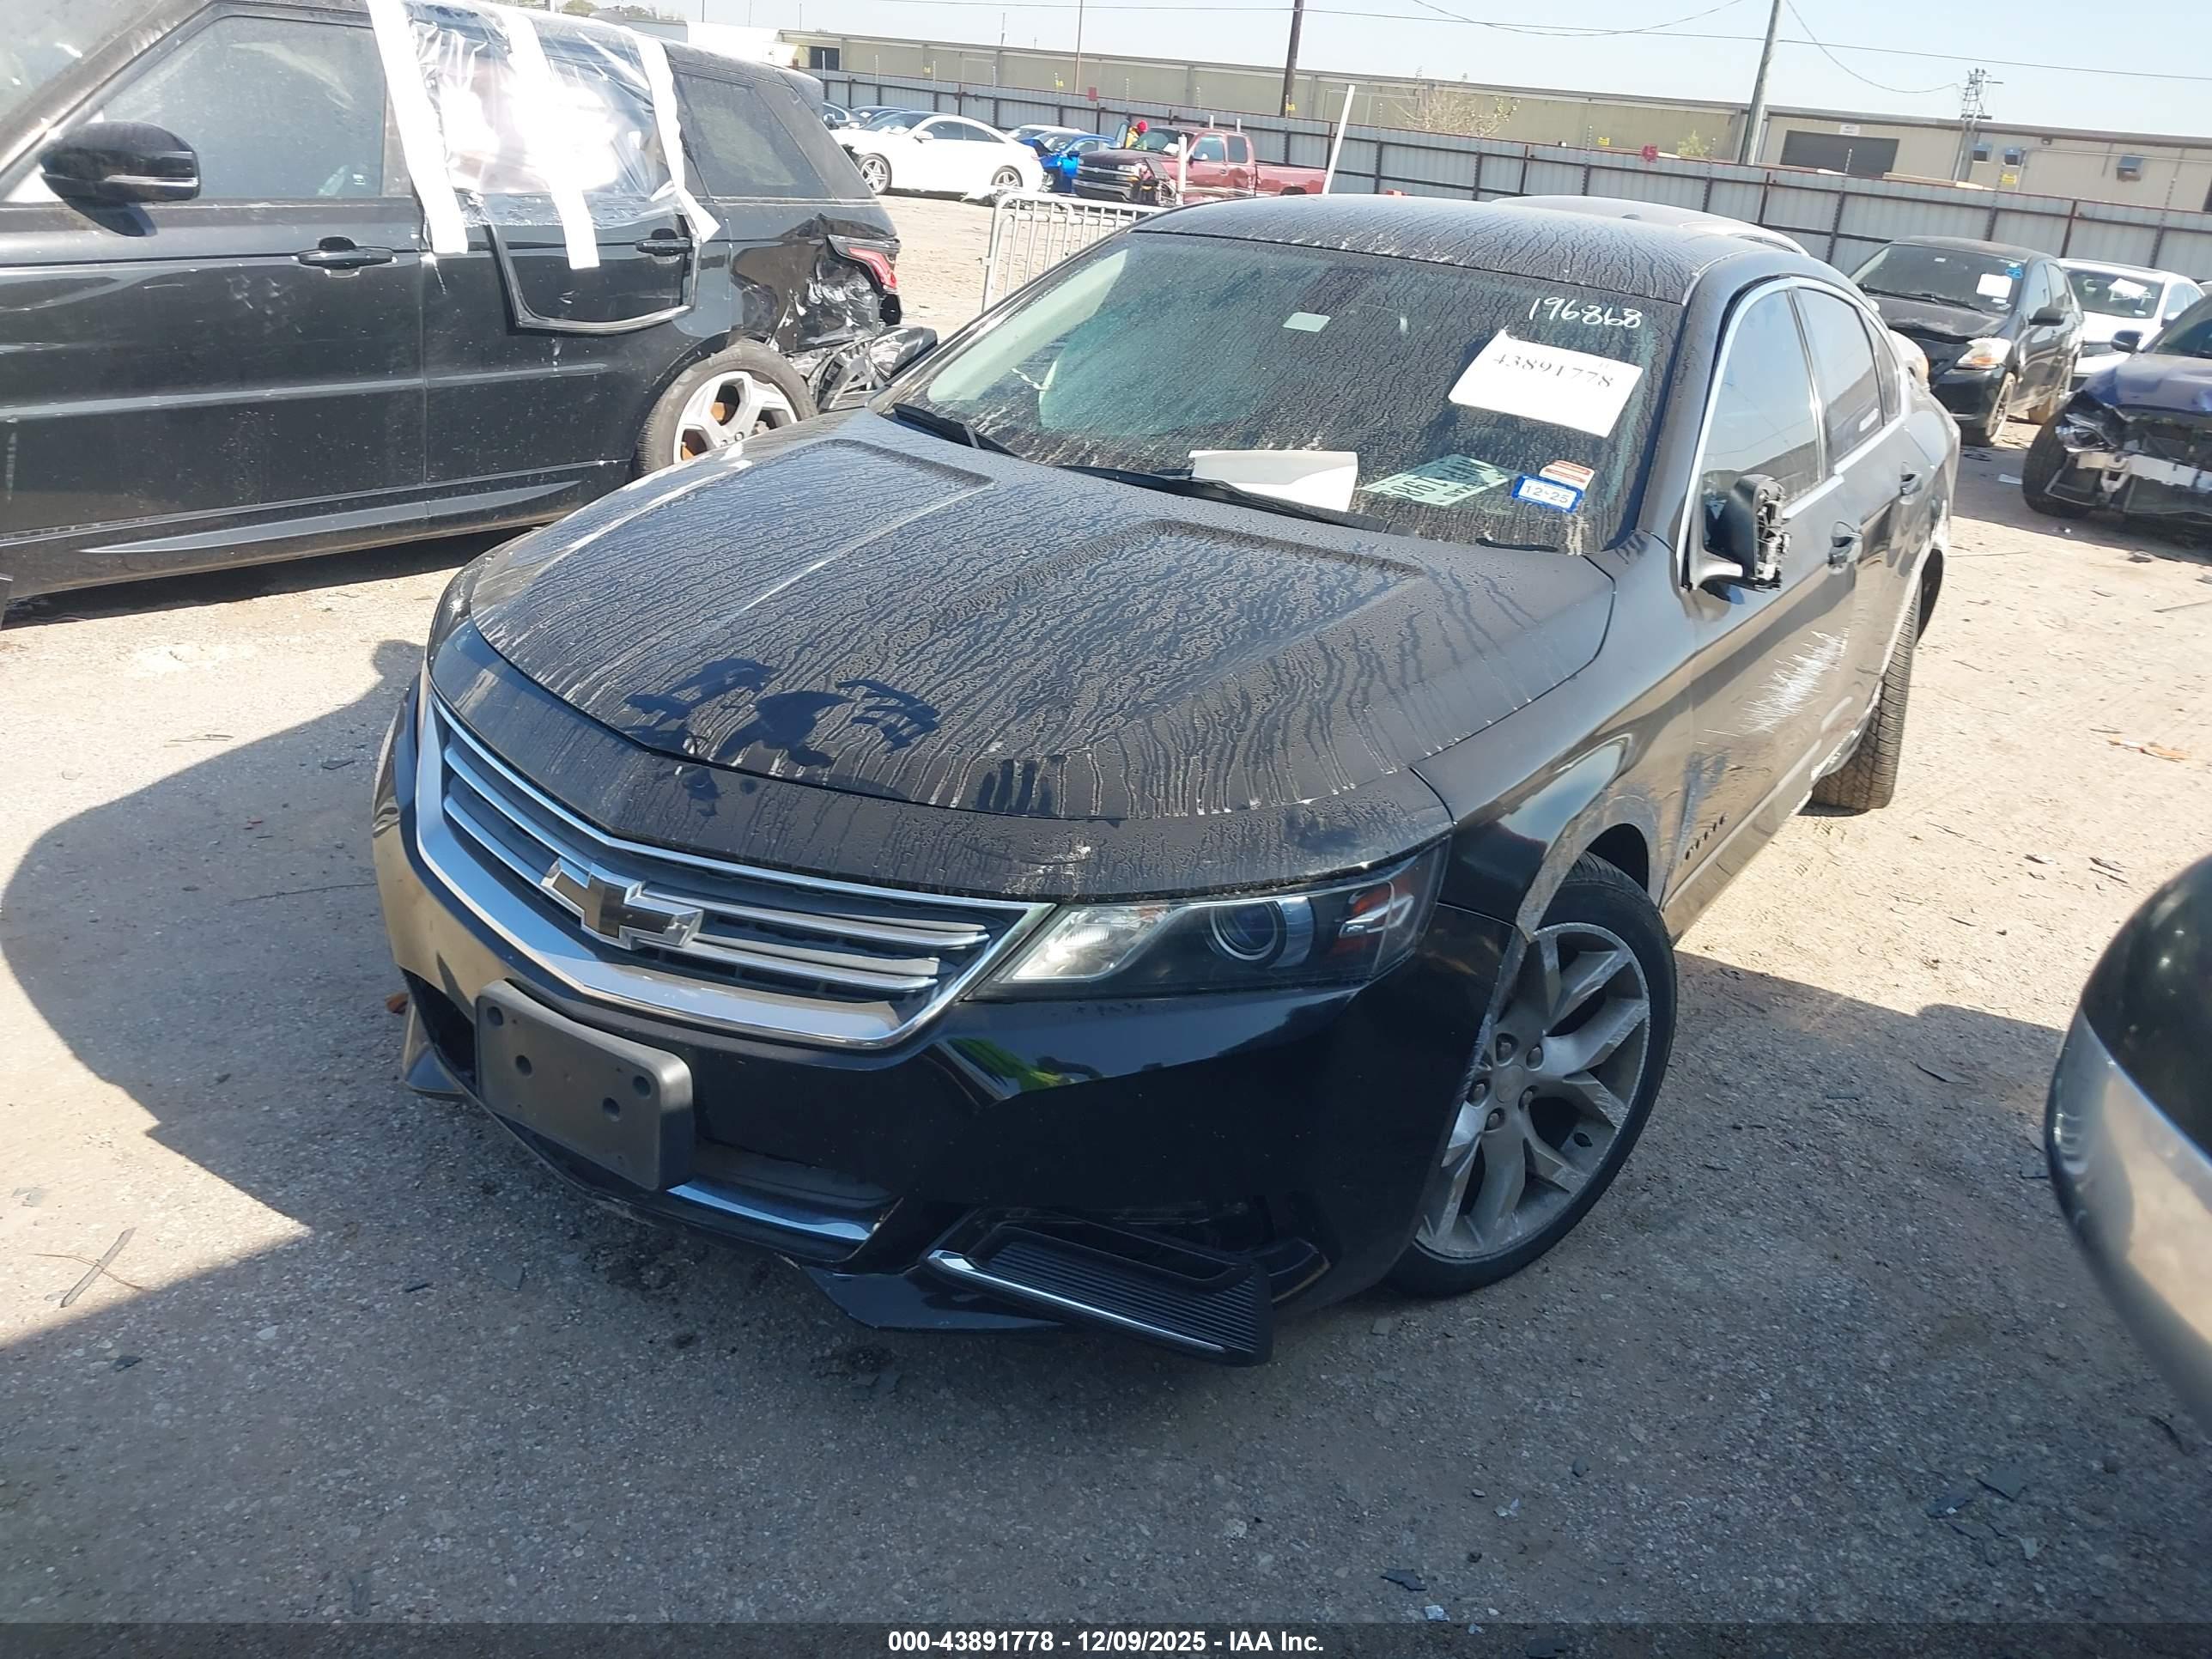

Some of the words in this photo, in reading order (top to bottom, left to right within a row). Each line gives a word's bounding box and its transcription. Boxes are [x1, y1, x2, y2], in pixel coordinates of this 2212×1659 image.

[1528, 296, 1643, 329] 196868
[1492, 353, 1614, 388] 43891778
[1525, 485, 1571, 503] 12-25
